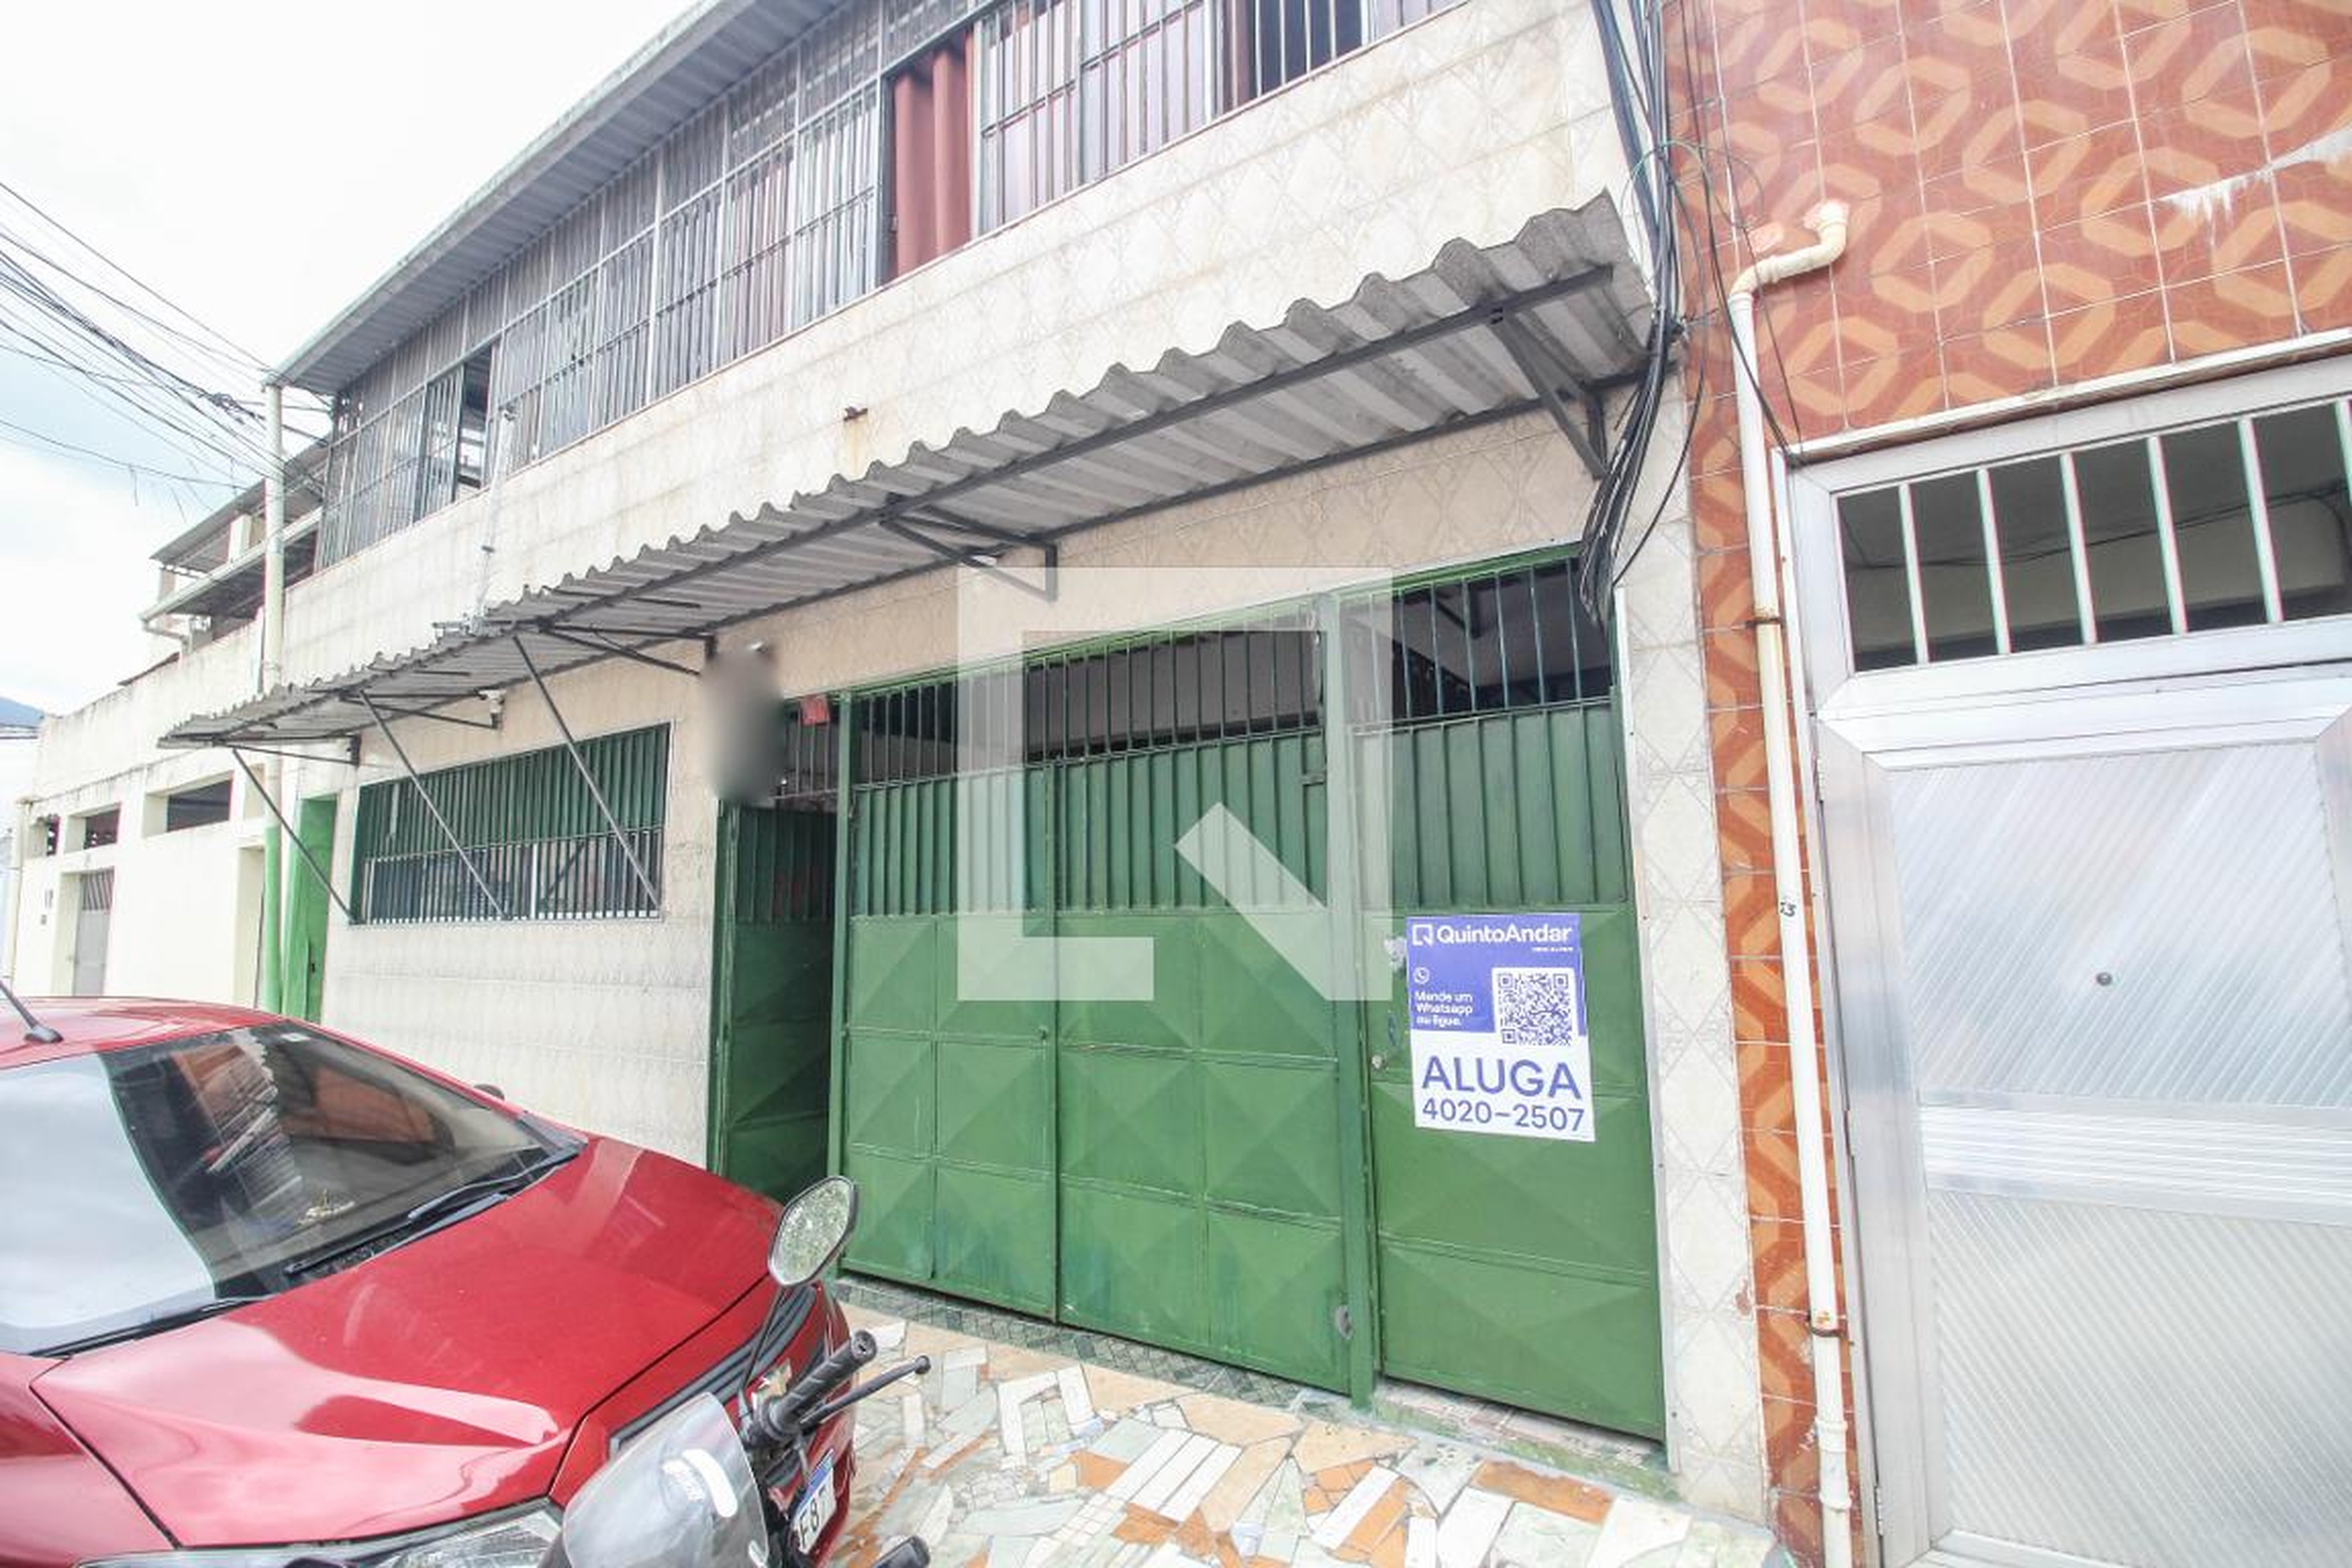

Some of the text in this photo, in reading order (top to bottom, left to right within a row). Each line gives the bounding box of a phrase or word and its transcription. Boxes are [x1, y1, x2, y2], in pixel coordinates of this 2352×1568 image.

[1437, 924, 1573, 944] QuintoAndar
[1415, 990, 1473, 1003] Mande um
[1422, 1055, 1582, 1099] ALUGA
[1422, 1098, 1585, 1132] 4020-2507
